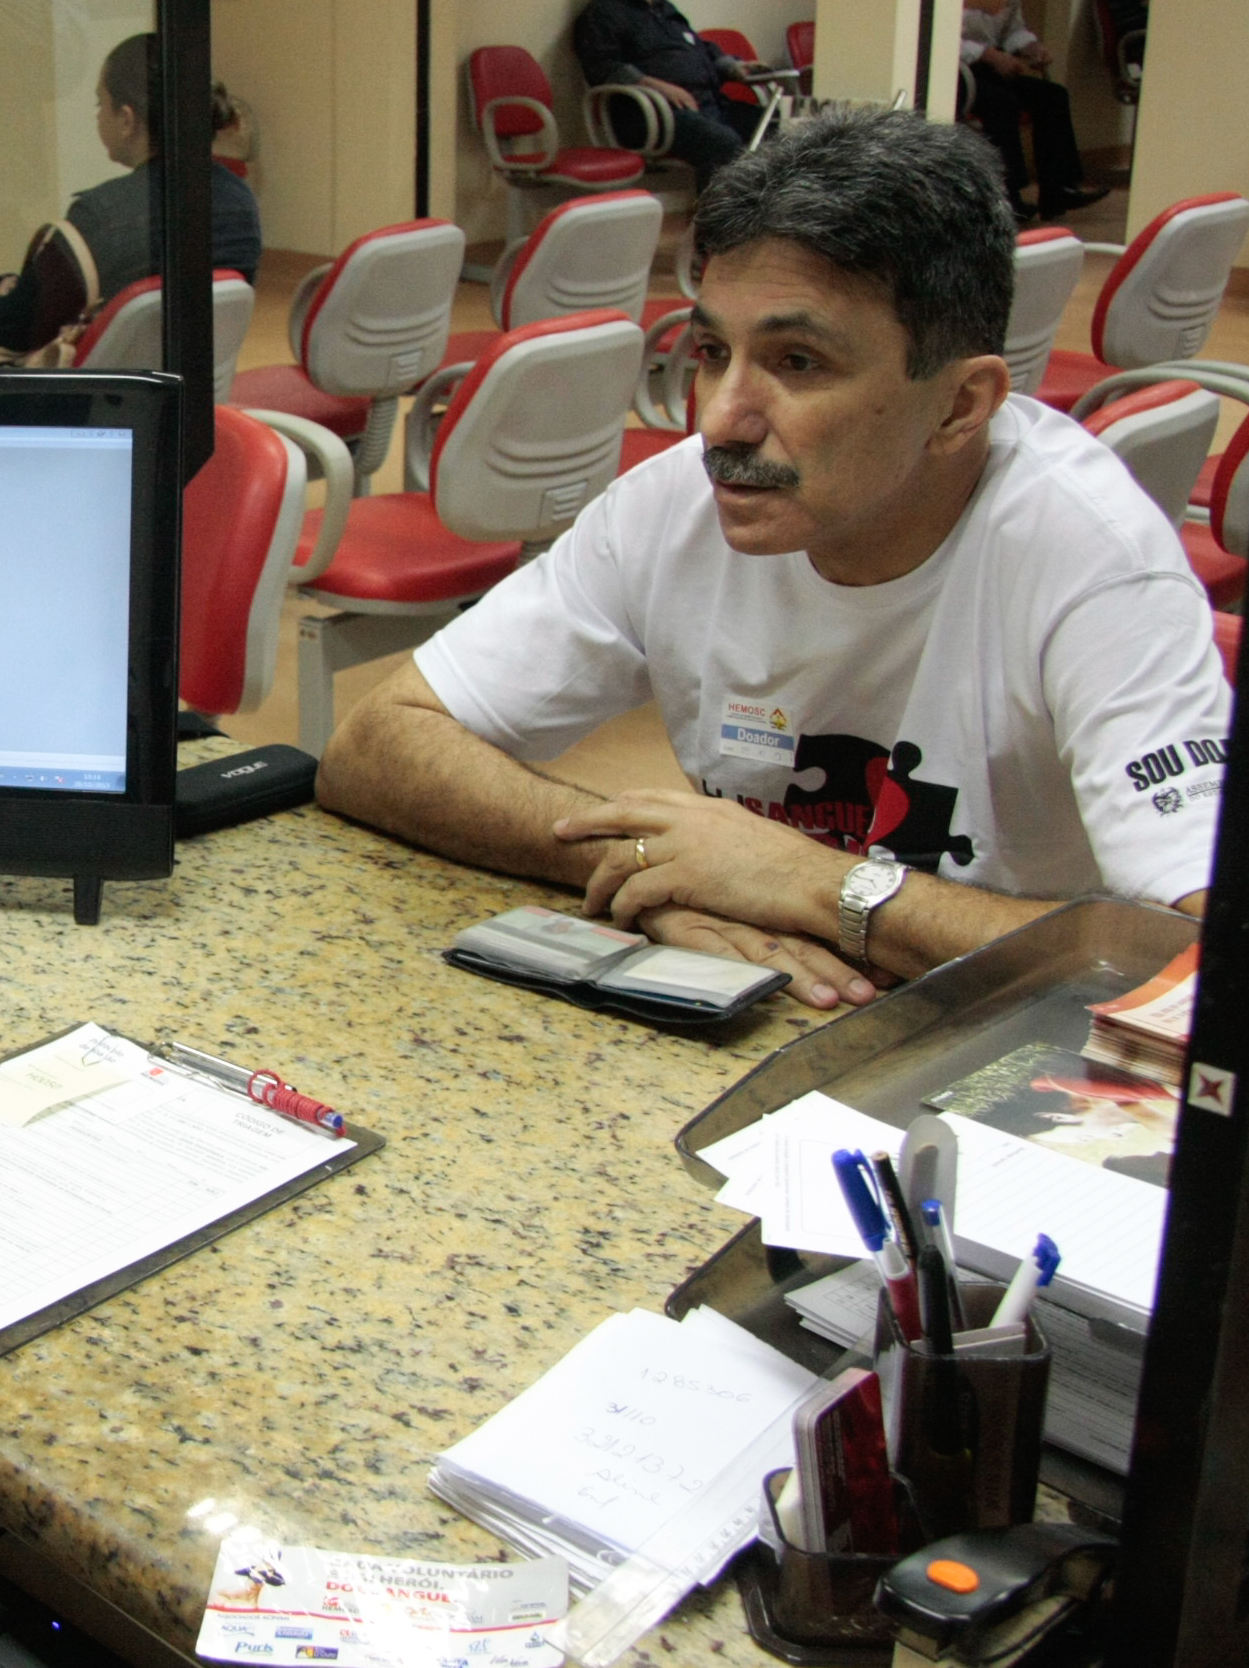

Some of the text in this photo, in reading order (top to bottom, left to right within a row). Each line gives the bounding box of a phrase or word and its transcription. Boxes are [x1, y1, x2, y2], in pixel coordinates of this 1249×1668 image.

[728, 702, 766, 717] HEMOSC
[737, 727, 780, 747] Doador
[1125, 743, 1184, 792] SOU
[232, 1118, 273, 1138] TRIAGEM
